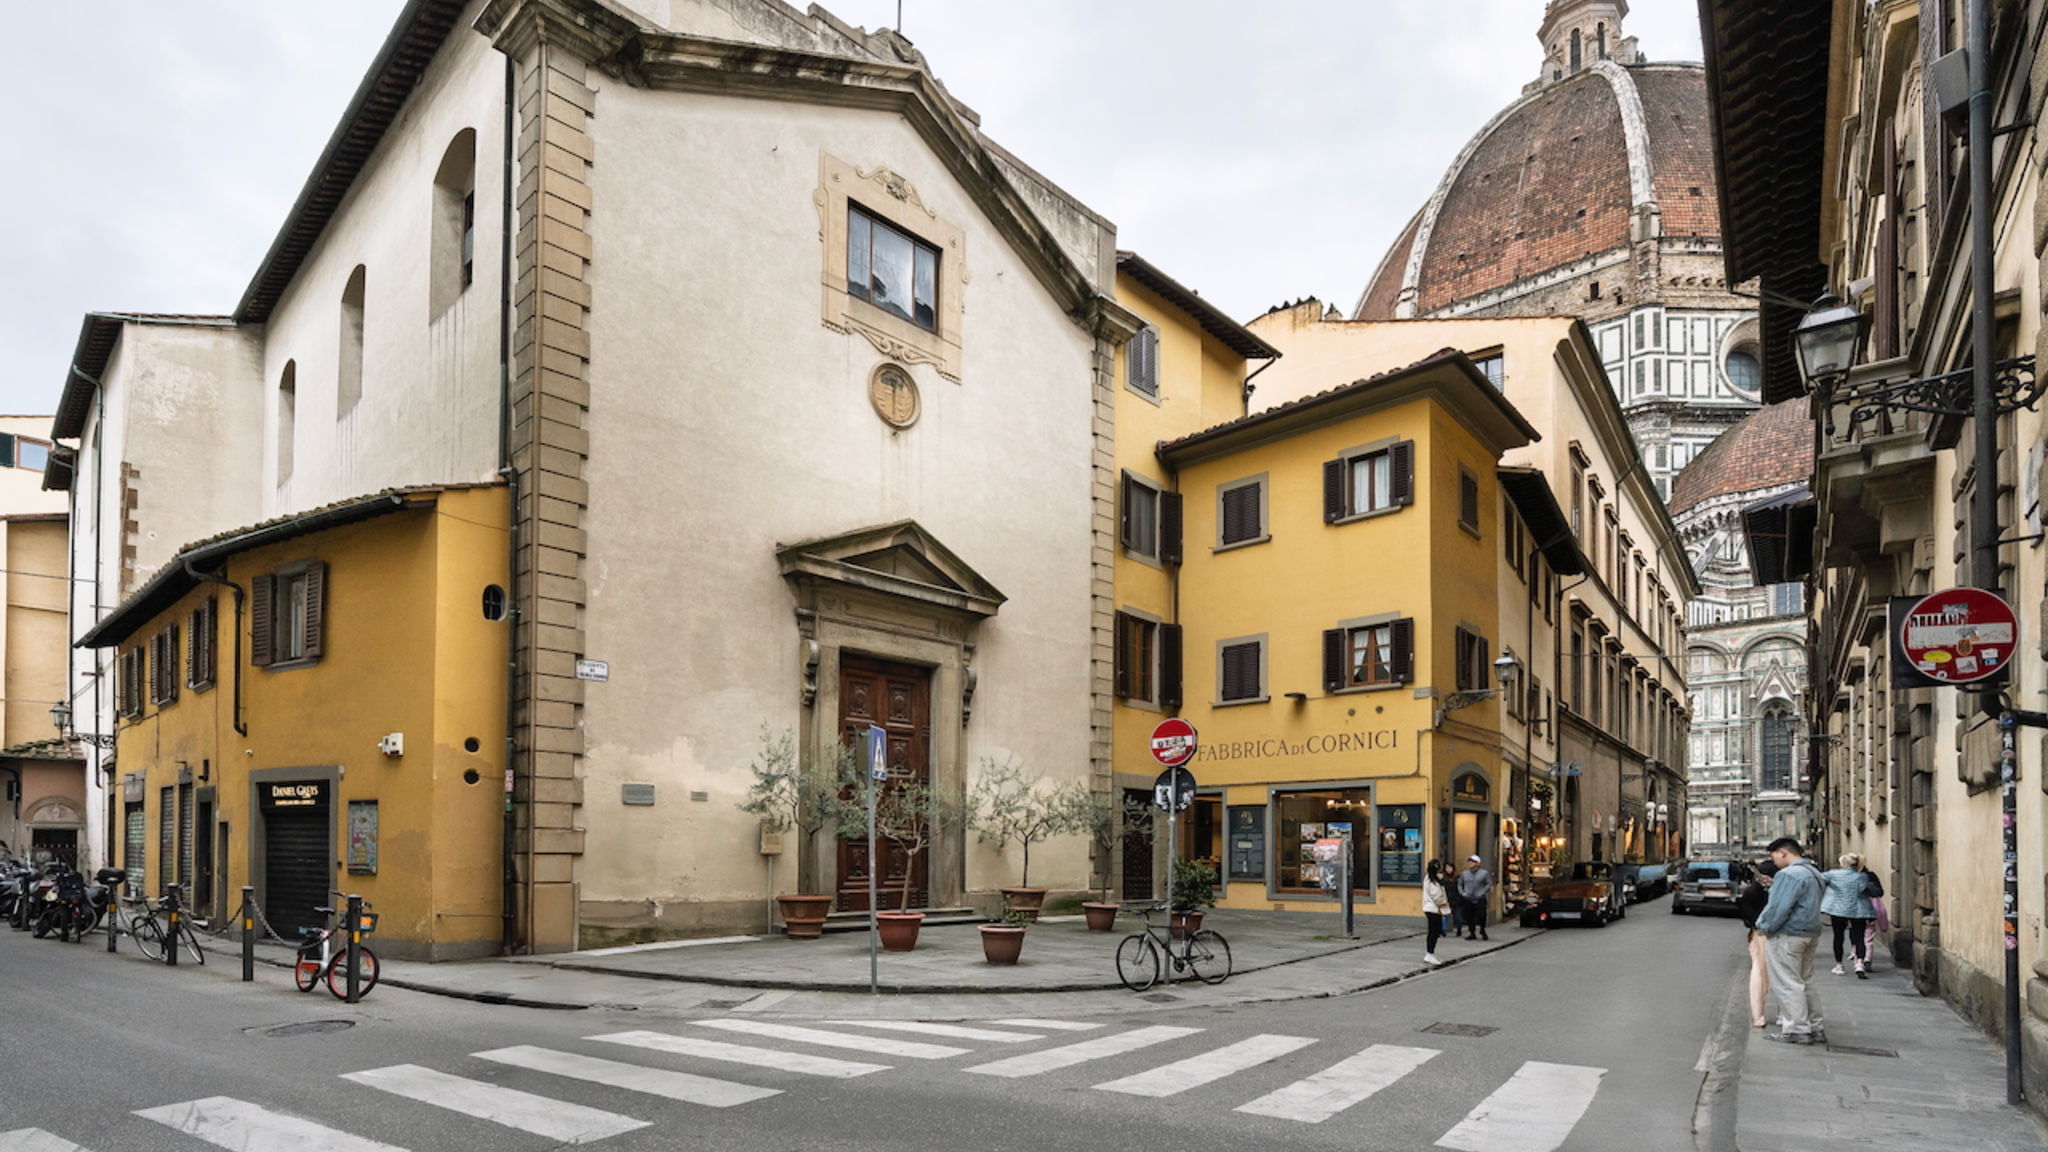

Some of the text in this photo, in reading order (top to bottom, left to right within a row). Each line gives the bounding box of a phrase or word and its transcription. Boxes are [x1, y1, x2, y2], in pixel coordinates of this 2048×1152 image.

[1197, 739, 1289, 761] FABBRICA
[1306, 730, 1398, 755] CORNICI
[272, 785, 296, 797] DANIEL
